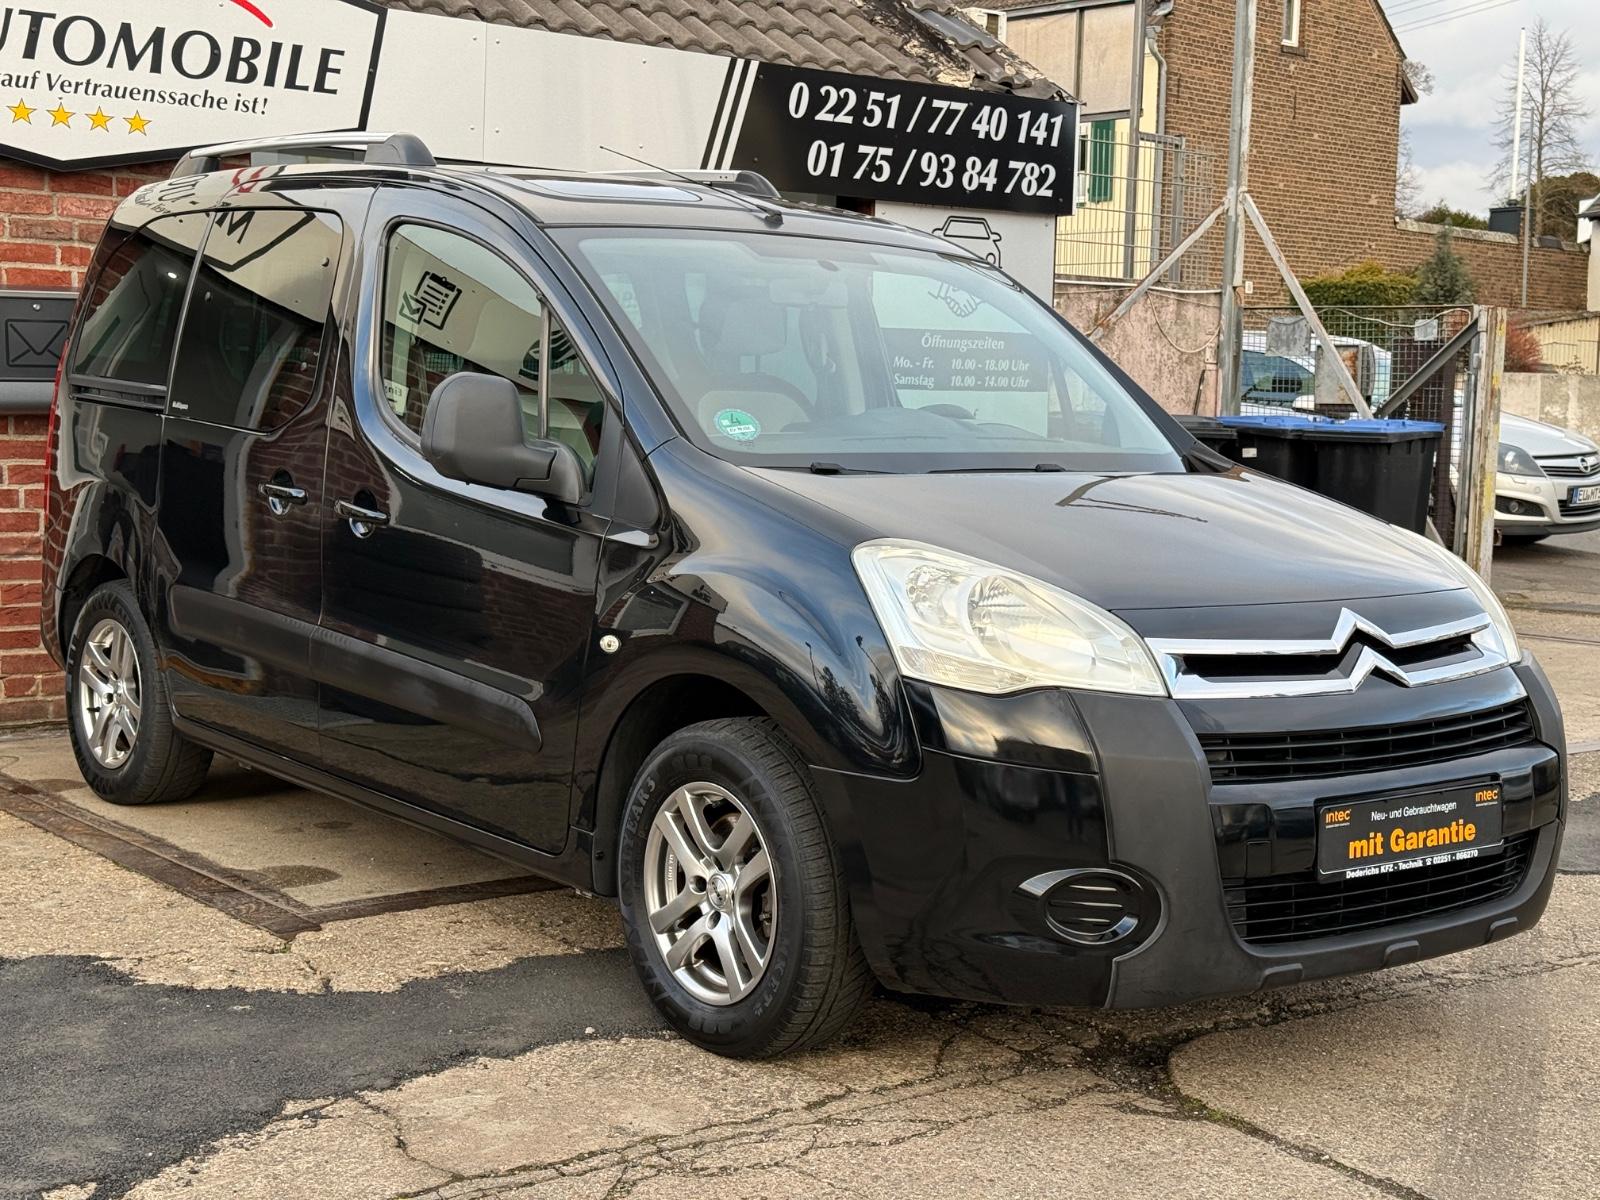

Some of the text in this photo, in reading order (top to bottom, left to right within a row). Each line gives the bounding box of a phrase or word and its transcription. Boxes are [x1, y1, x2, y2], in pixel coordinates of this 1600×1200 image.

[0, 70, 269, 116] auf Vertrauenssache ist!
[788, 82, 810, 118] 0
[814, 85, 857, 124] 22
[862, 91, 902, 130] 51
[927, 99, 968, 136] 77
[971, 105, 1008, 142] 40
[1016, 110, 1064, 148] 141
[807, 139, 846, 178] 01
[853, 144, 893, 184] 75
[919, 151, 957, 189] 93
[962, 155, 999, 193] 84
[1004, 160, 1057, 198] 782
[921, 332, 1005, 352] Öffnungszeiten
[893, 356, 914, 369] Mo.
[922, 356, 935, 369] Fr.
[950, 359, 976, 371] 10.00
[984, 359, 1010, 371] 18.00
[1011, 359, 1030, 372] Uhr
[894, 373, 935, 390] Samstag
[950, 375, 976, 387] 10.00
[984, 376, 1009, 388] 14.00
[1010, 376, 1030, 388] Uhr
[1371, 802, 1457, 822] Neu- und Gebrauchtwagen
[1349, 819, 1477, 859] mit Garantie
[1346, 866, 1379, 879] Dederichs
[1380, 863, 1394, 873] KFZ
[1398, 859, 1423, 871] Technik
